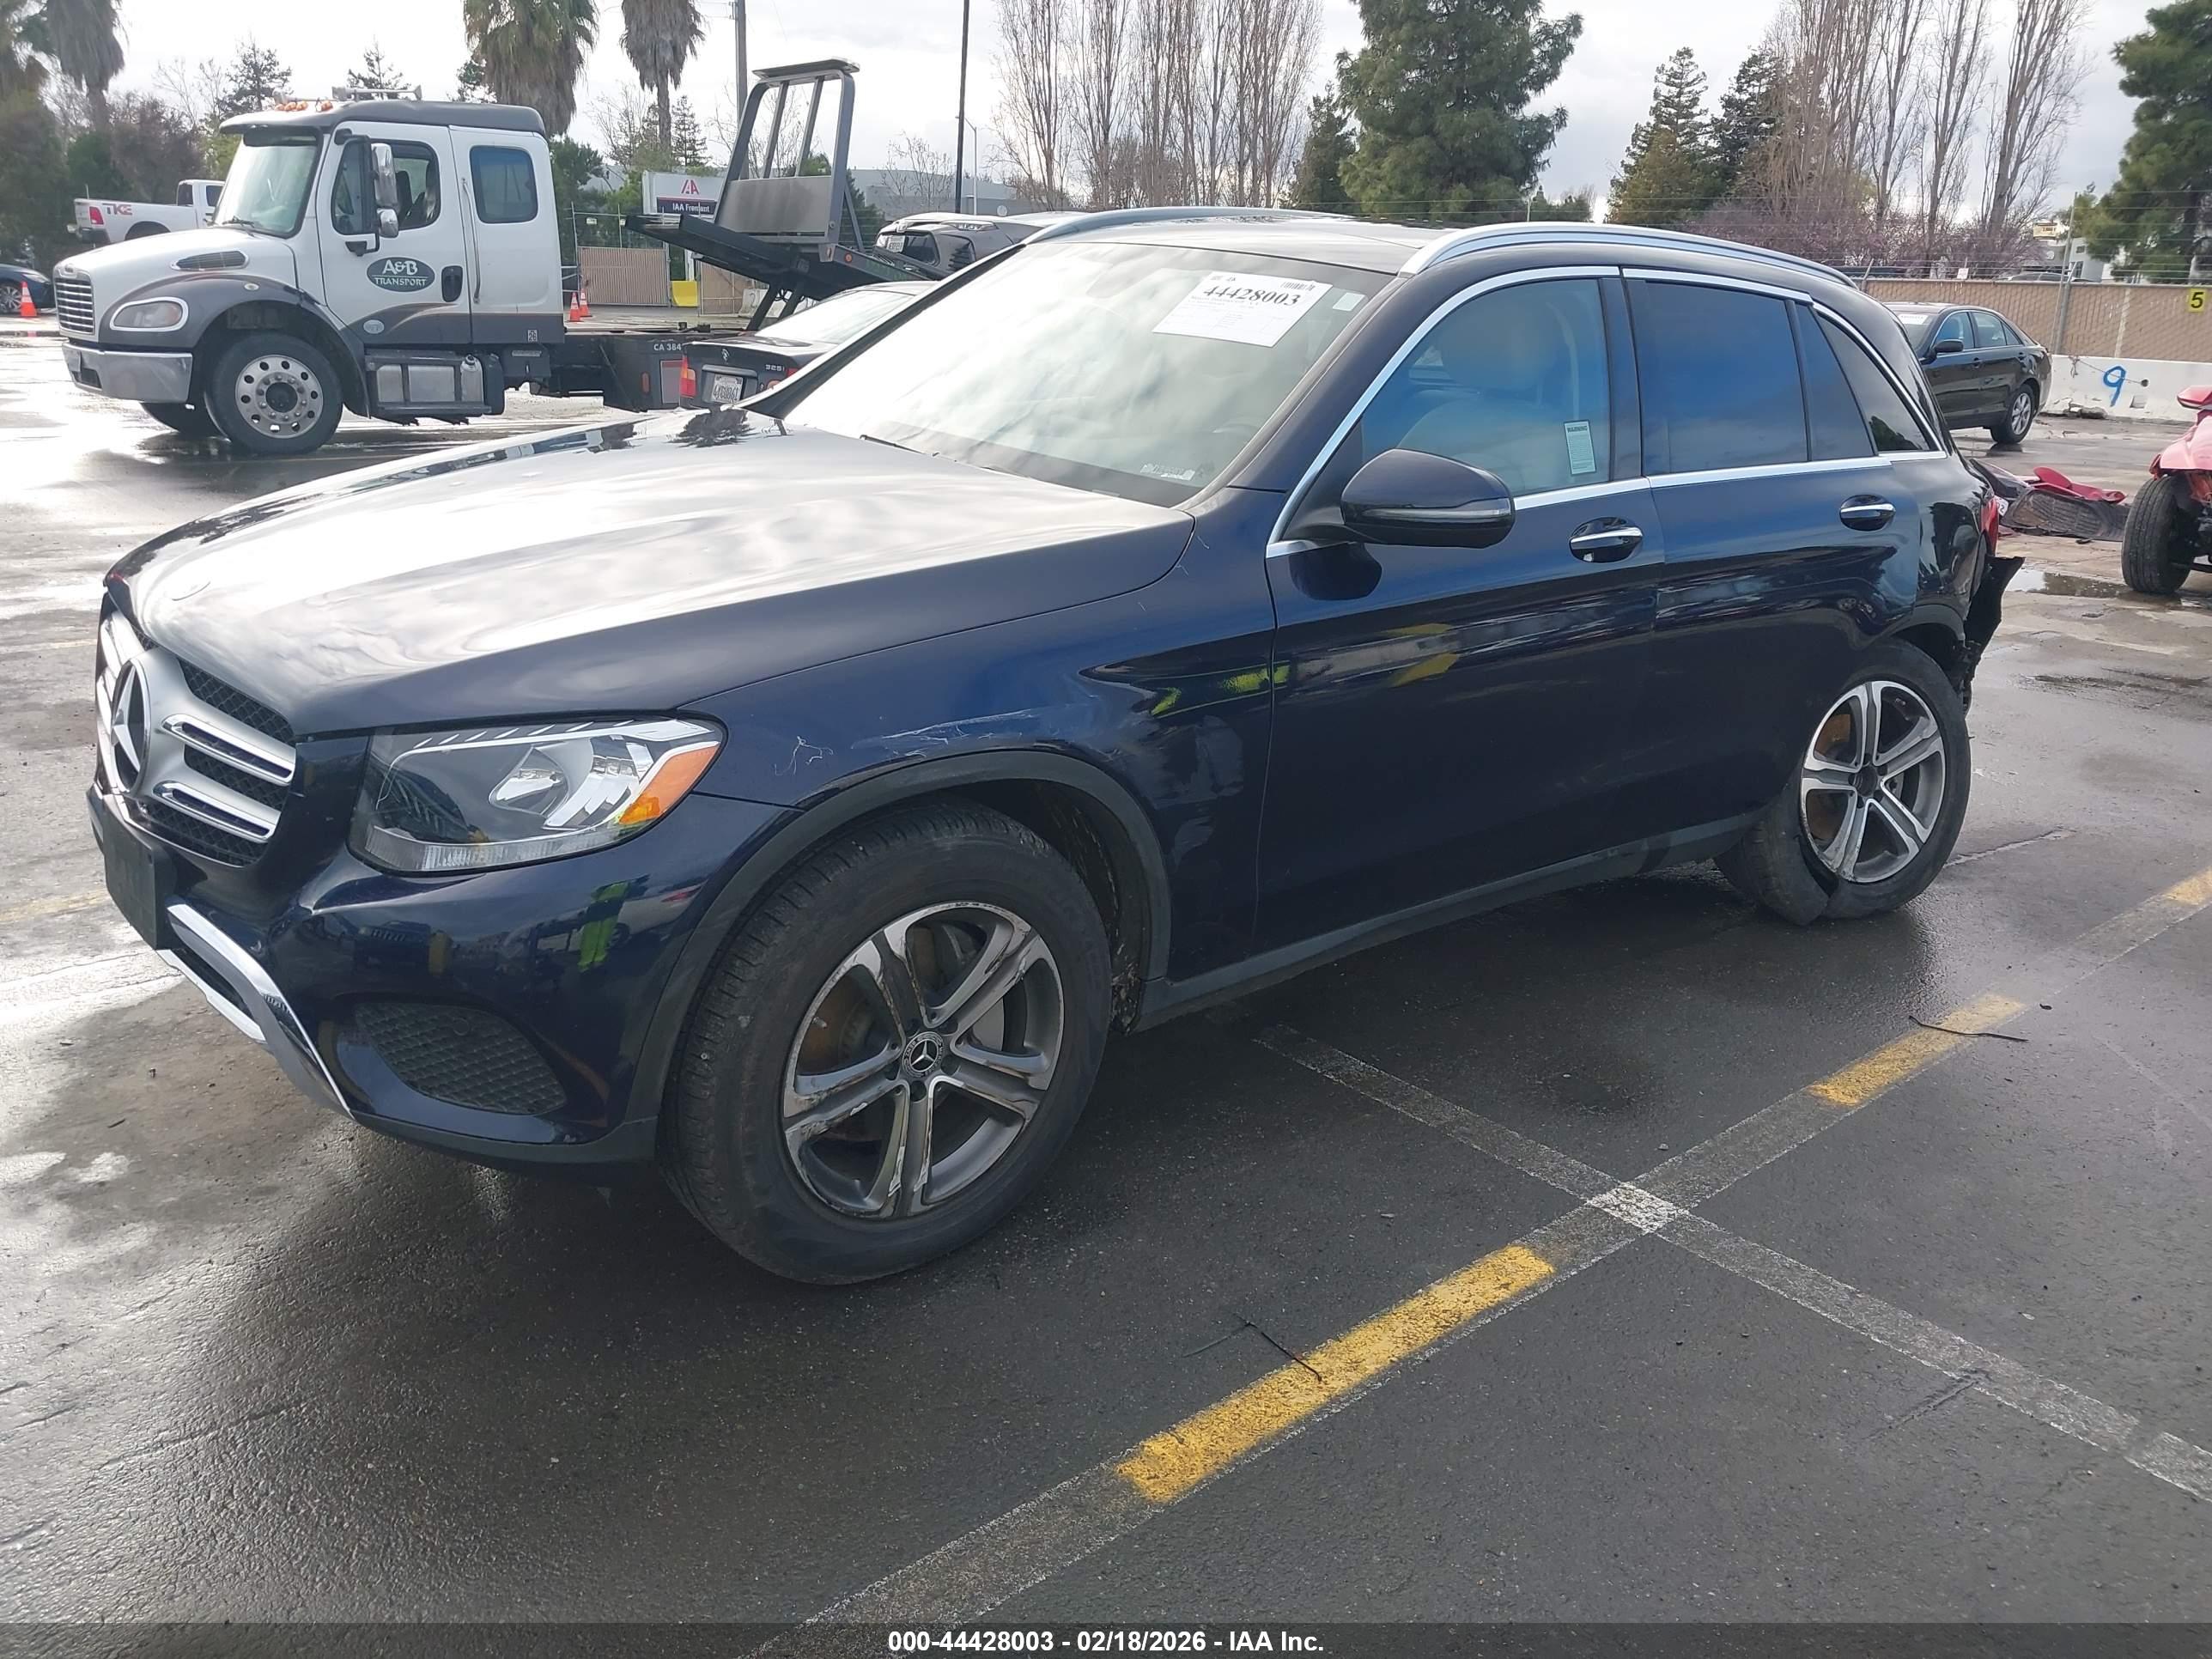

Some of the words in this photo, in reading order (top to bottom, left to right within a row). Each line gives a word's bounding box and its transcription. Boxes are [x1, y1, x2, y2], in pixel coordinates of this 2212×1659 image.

[672, 203, 684, 211] IAA
[382, 259, 418, 275] A&B
[374, 277, 427, 286] TRANSPORT
[1203, 286, 1302, 307] 44428003
[2191, 291, 2204, 309] 5
[2103, 365, 2127, 407] 9
